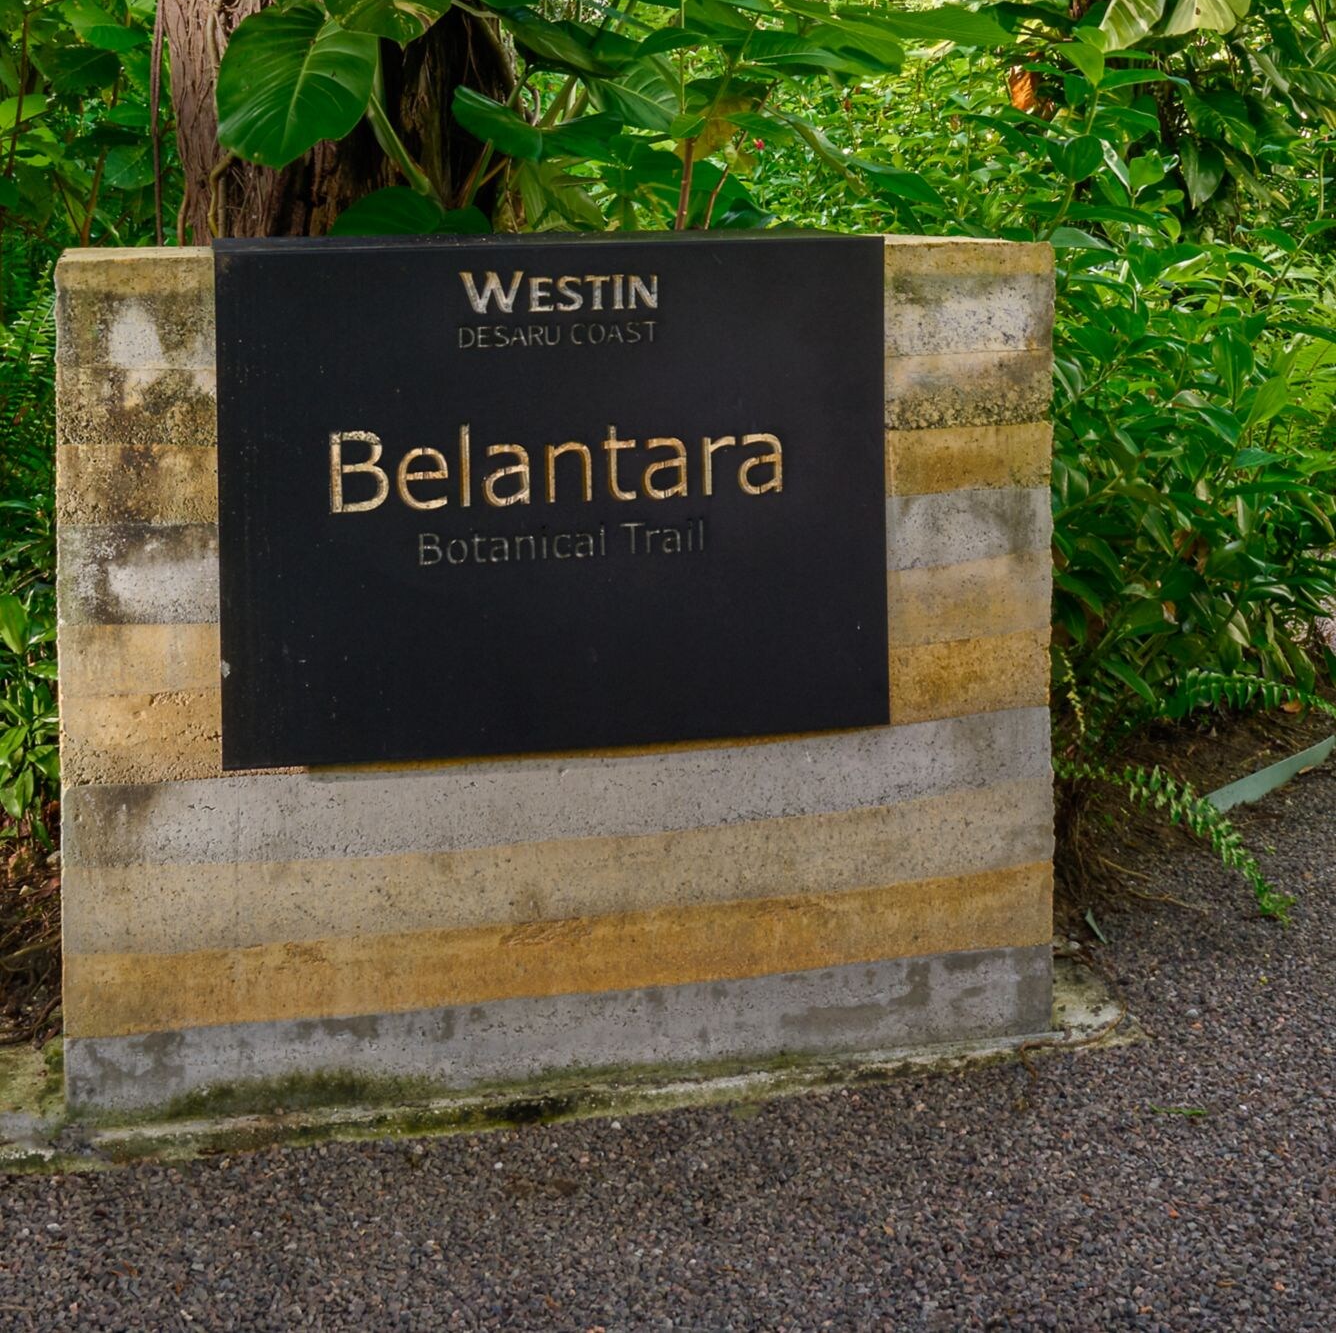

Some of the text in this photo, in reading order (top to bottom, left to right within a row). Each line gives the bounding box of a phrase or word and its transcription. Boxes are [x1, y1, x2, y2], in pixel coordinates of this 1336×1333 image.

[458, 270, 659, 314] WESTIN
[458, 321, 659, 349] DESARU COAST
[330, 424, 784, 514] Belantara
[418, 519, 705, 565] Botanical Trail
